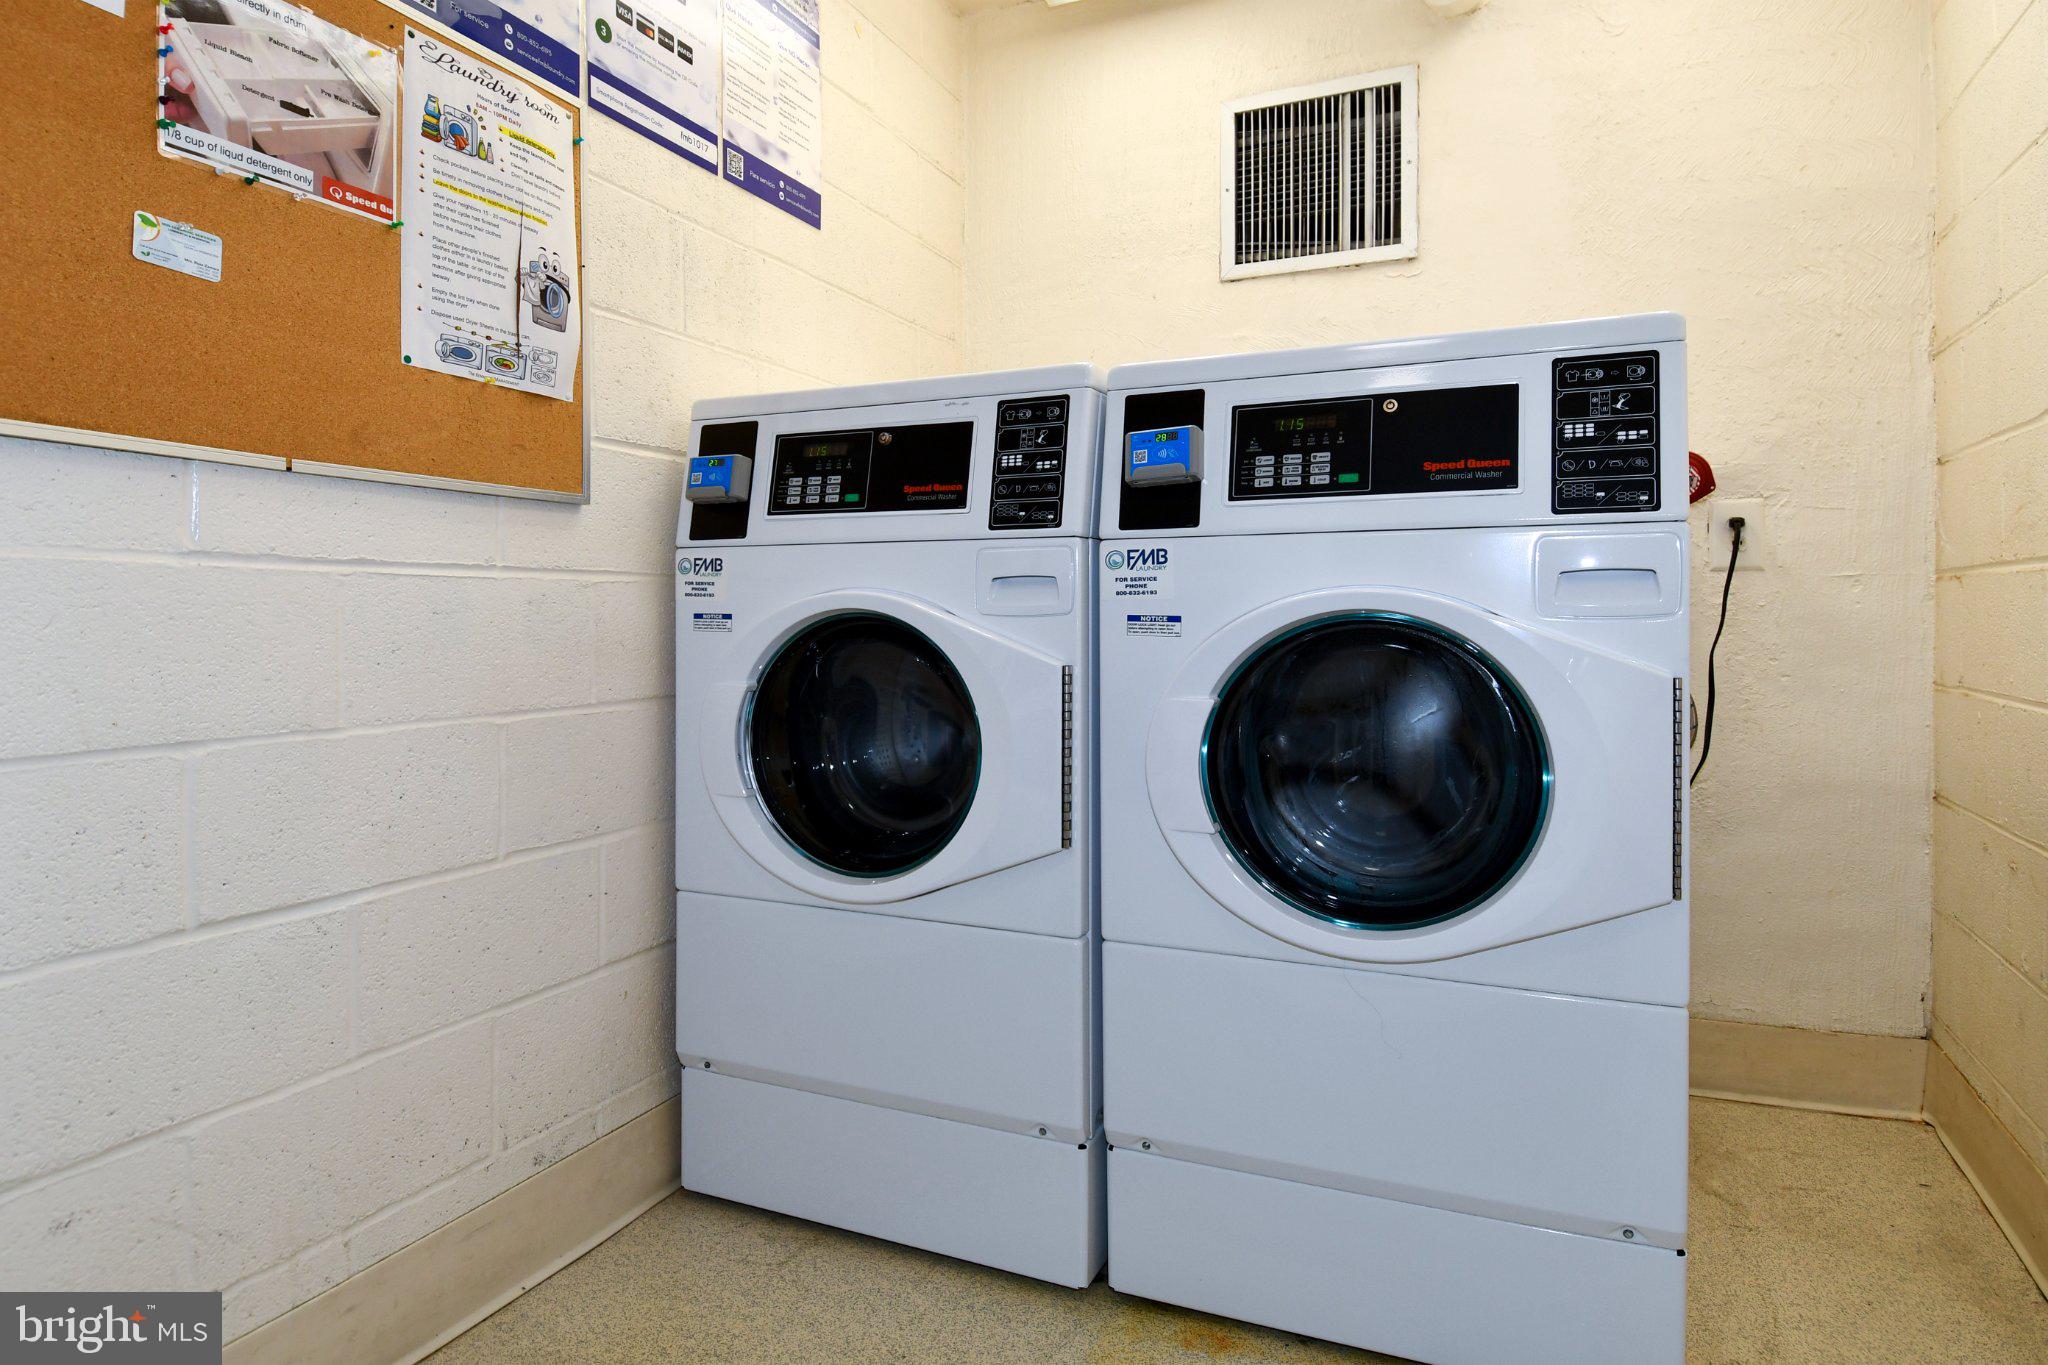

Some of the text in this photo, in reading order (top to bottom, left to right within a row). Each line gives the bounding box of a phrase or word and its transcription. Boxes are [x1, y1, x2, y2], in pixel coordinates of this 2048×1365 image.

[237, 0, 307, 31] irectly in drum
[451, 2, 490, 28] For service
[617, 4, 632, 19] VISA
[600, 25, 606, 36] 3
[204, 38, 227, 52] Liquid
[269, 36, 320, 62] Fabric Softener
[242, 84, 274, 101] Detergent
[419, 41, 560, 125] Laundry room
[321, 89, 350, 105] Pre Wash
[477, 92, 492, 105] Hours
[501, 104, 520, 117] Service
[493, 110, 522, 128] 10PM Daily
[596, 86, 624, 106] Smartphone
[624, 102, 650, 122] Registration
[680, 131, 709, 153] fmb1017
[185, 136, 204, 148] cup
[208, 142, 218, 152] of
[220, 146, 243, 161] liqud
[247, 156, 292, 178] detergent
[294, 170, 312, 186] only
[433, 155, 450, 165] Check
[451, 161, 470, 173] pockets
[471, 169, 486, 179] before
[487, 175, 503, 186] placing
[442, 171, 456, 181] timely
[463, 180, 485, 192] removing
[486, 188, 502, 197] clothes
[749, 170, 760, 180] Para
[345, 191, 378, 210] Speed
[432, 192, 445, 200] Give
[458, 202, 481, 213] neighbors
[433, 178, 448, 188] Leave
[459, 189, 472, 198] doors
[487, 199, 506, 210] washers
[433, 211, 449, 221] before
[450, 218, 472, 230] removing
[485, 229, 501, 239] clothes
[458, 211, 470, 219] cycle
[432, 236, 447, 244] Place
[461, 246, 481, 255] people's
[482, 252, 500, 262] finished
[432, 244, 450, 253] clothes
[451, 250, 465, 258] either
[476, 258, 494, 268] laundry
[432, 263, 453, 273] machine
[467, 273, 481, 282] giving
[482, 278, 506, 289] appropriate
[432, 287, 448, 296] Empty
[431, 309, 452, 319] Dispose
[466, 318, 478, 326] Dryer
[480, 322, 494, 331] Sheets
[1156, 434, 1166, 442] 28
[1423, 458, 1510, 472] Speed Queen
[1430, 470, 1503, 481] Commercial Washer
[904, 483, 963, 493] Speed Queen
[693, 558, 723, 575] FMB
[1127, 548, 1168, 570] FMB
